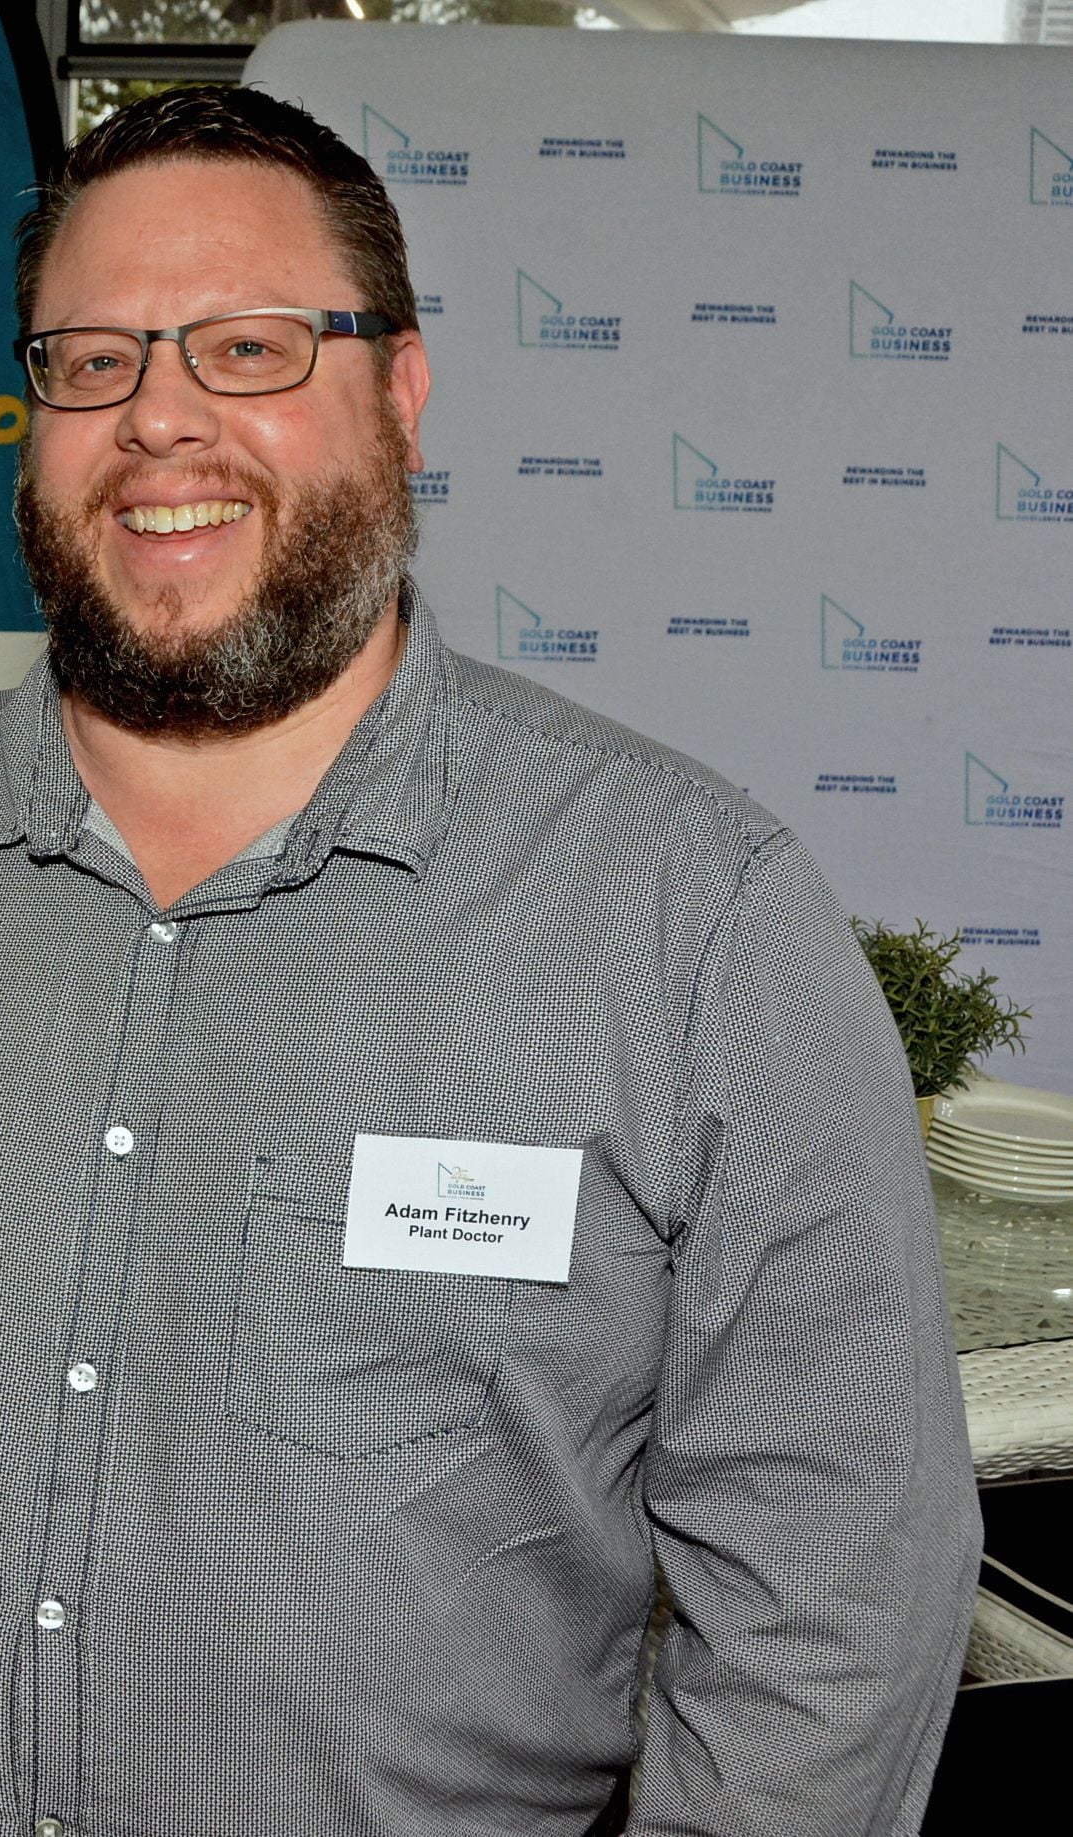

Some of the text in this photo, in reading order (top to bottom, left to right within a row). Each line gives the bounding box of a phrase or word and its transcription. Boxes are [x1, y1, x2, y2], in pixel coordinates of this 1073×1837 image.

[605, 139, 624, 148] THE
[427, 151, 469, 162] COAST
[539, 147, 563, 157] BEST
[579, 148, 625, 158] BUSINESS
[937, 151, 956, 160] THE
[387, 163, 468, 176] BUSINESS
[760, 162, 802, 172] COAST
[871, 159, 895, 168] BEST
[911, 160, 957, 170] BUSINESS
[720, 174, 801, 187] BUSINESS
[757, 304, 775, 313] THE
[579, 317, 621, 327] COAST
[691, 313, 714, 322] BEST
[730, 314, 776, 323] BUSINESS
[540, 329, 620, 341] BUSINESS
[910, 327, 952, 338] COAST
[870, 339, 951, 352] BUSINESS
[583, 457, 601, 466] THE
[906, 468, 924, 477] THE
[733, 480, 775, 490] COAST
[842, 477, 865, 485] BEST
[881, 478, 926, 487] BUSINESS
[695, 491, 774, 504] BUSINESS
[730, 618, 748, 627] THE
[558, 630, 598, 640] COAST
[667, 627, 690, 635] BEST
[705, 628, 750, 637] BUSINESS
[1053, 628, 1070, 637] THE
[880, 640, 921, 650] COAST
[989, 636, 1012, 645] BEST
[1027, 638, 1072, 647] BUSINESS
[519, 642, 597, 654] BUSINESS
[843, 651, 920, 664] BUSINESS
[877, 775, 895, 784] THE
[814, 783, 837, 792] BEST
[852, 784, 897, 793] BUSINESS
[1023, 797, 1064, 807] COAST
[986, 808, 1063, 820] BUSINESS
[1022, 928, 1039, 937] THE
[960, 937, 982, 945] BEST
[997, 938, 1041, 946] BUSINESS
[447, 1189, 485, 1197] BUSINESS
[385, 1203, 530, 1231] Adam Fitzhenry
[409, 1225, 503, 1243] Plant Doctor
